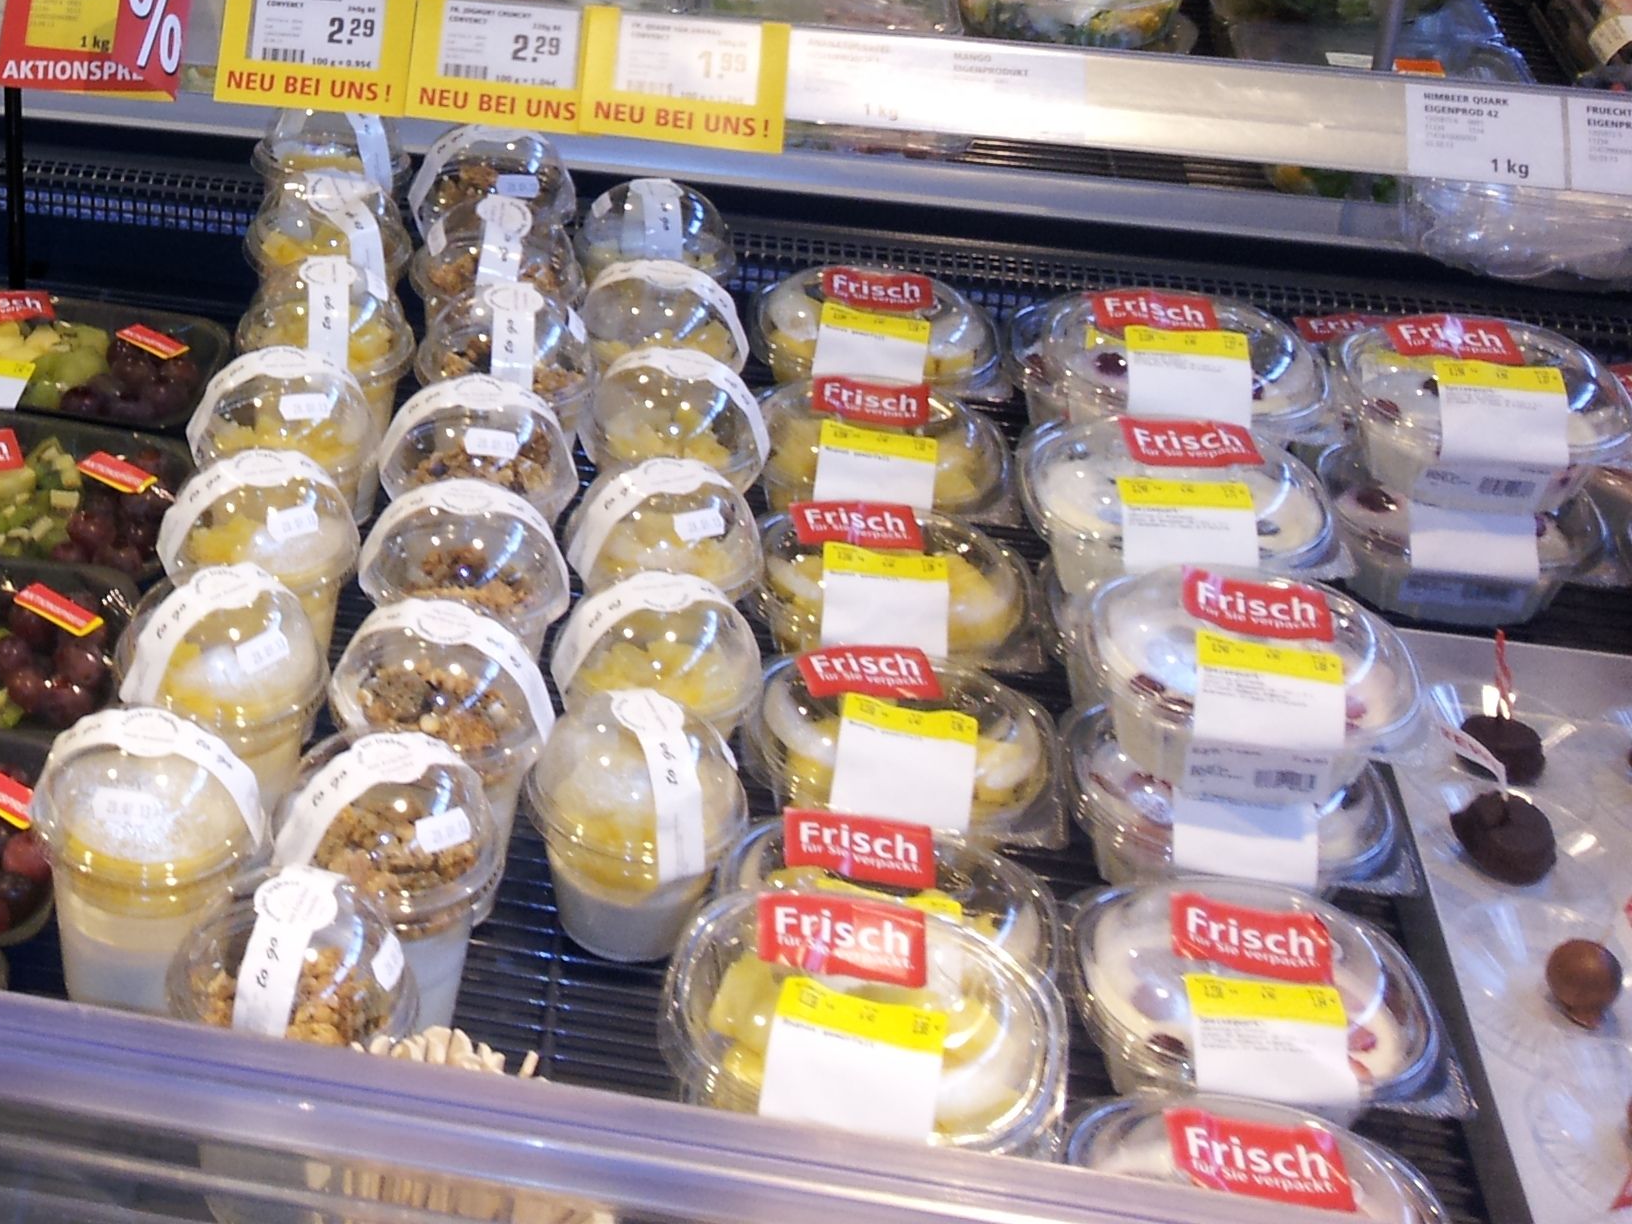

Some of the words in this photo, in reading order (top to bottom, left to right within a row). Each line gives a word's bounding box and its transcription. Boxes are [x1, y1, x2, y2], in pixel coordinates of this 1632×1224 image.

[81, 36, 87, 47] 1
[92, 37, 110, 52] kg
[327, 17, 375, 45] 2.29
[511, 34, 560, 62] 2.29
[953, 52, 992, 63] MANGO
[698, 51, 747, 80] 1.99
[227, 71, 275, 92] NEU
[284, 76, 320, 97] BEI
[330, 80, 378, 102] UNS
[1424, 92, 1469, 103] HIMBEER
[1473, 96, 1509, 107] QUARK
[419, 87, 468, 109] NEU
[479, 94, 515, 115] BEI
[526, 98, 576, 121] UNS
[879, 104, 898, 121] kg
[1424, 104, 1484, 117] EIGENPROD
[1487, 110, 1499, 119] 42
[593, 102, 644, 125] NEU
[656, 109, 693, 130] BEI
[704, 113, 756, 137] UNS
[1491, 159, 1499, 173] 1
[1507, 159, 1529, 179] kg
[833, 275, 921, 301] Frisch
[1104, 297, 1206, 324] Frisch
[1398, 323, 1503, 350] Frisch
[823, 383, 919, 413] Frisch
[1132, 427, 1242, 451] Frisch
[804, 506, 905, 534] Frisch
[1197, 582, 1317, 623] Frisch
[811, 653, 921, 679] Frisch
[799, 821, 918, 863] Frisch
[773, 906, 910, 956] Frisch
[1186, 906, 1315, 959] Frisch
[1189, 932, 1211, 946] für
[1215, 942, 1240, 957] Sie
[266, 937, 279, 960] go
[1184, 1127, 1328, 1179] Frisch
